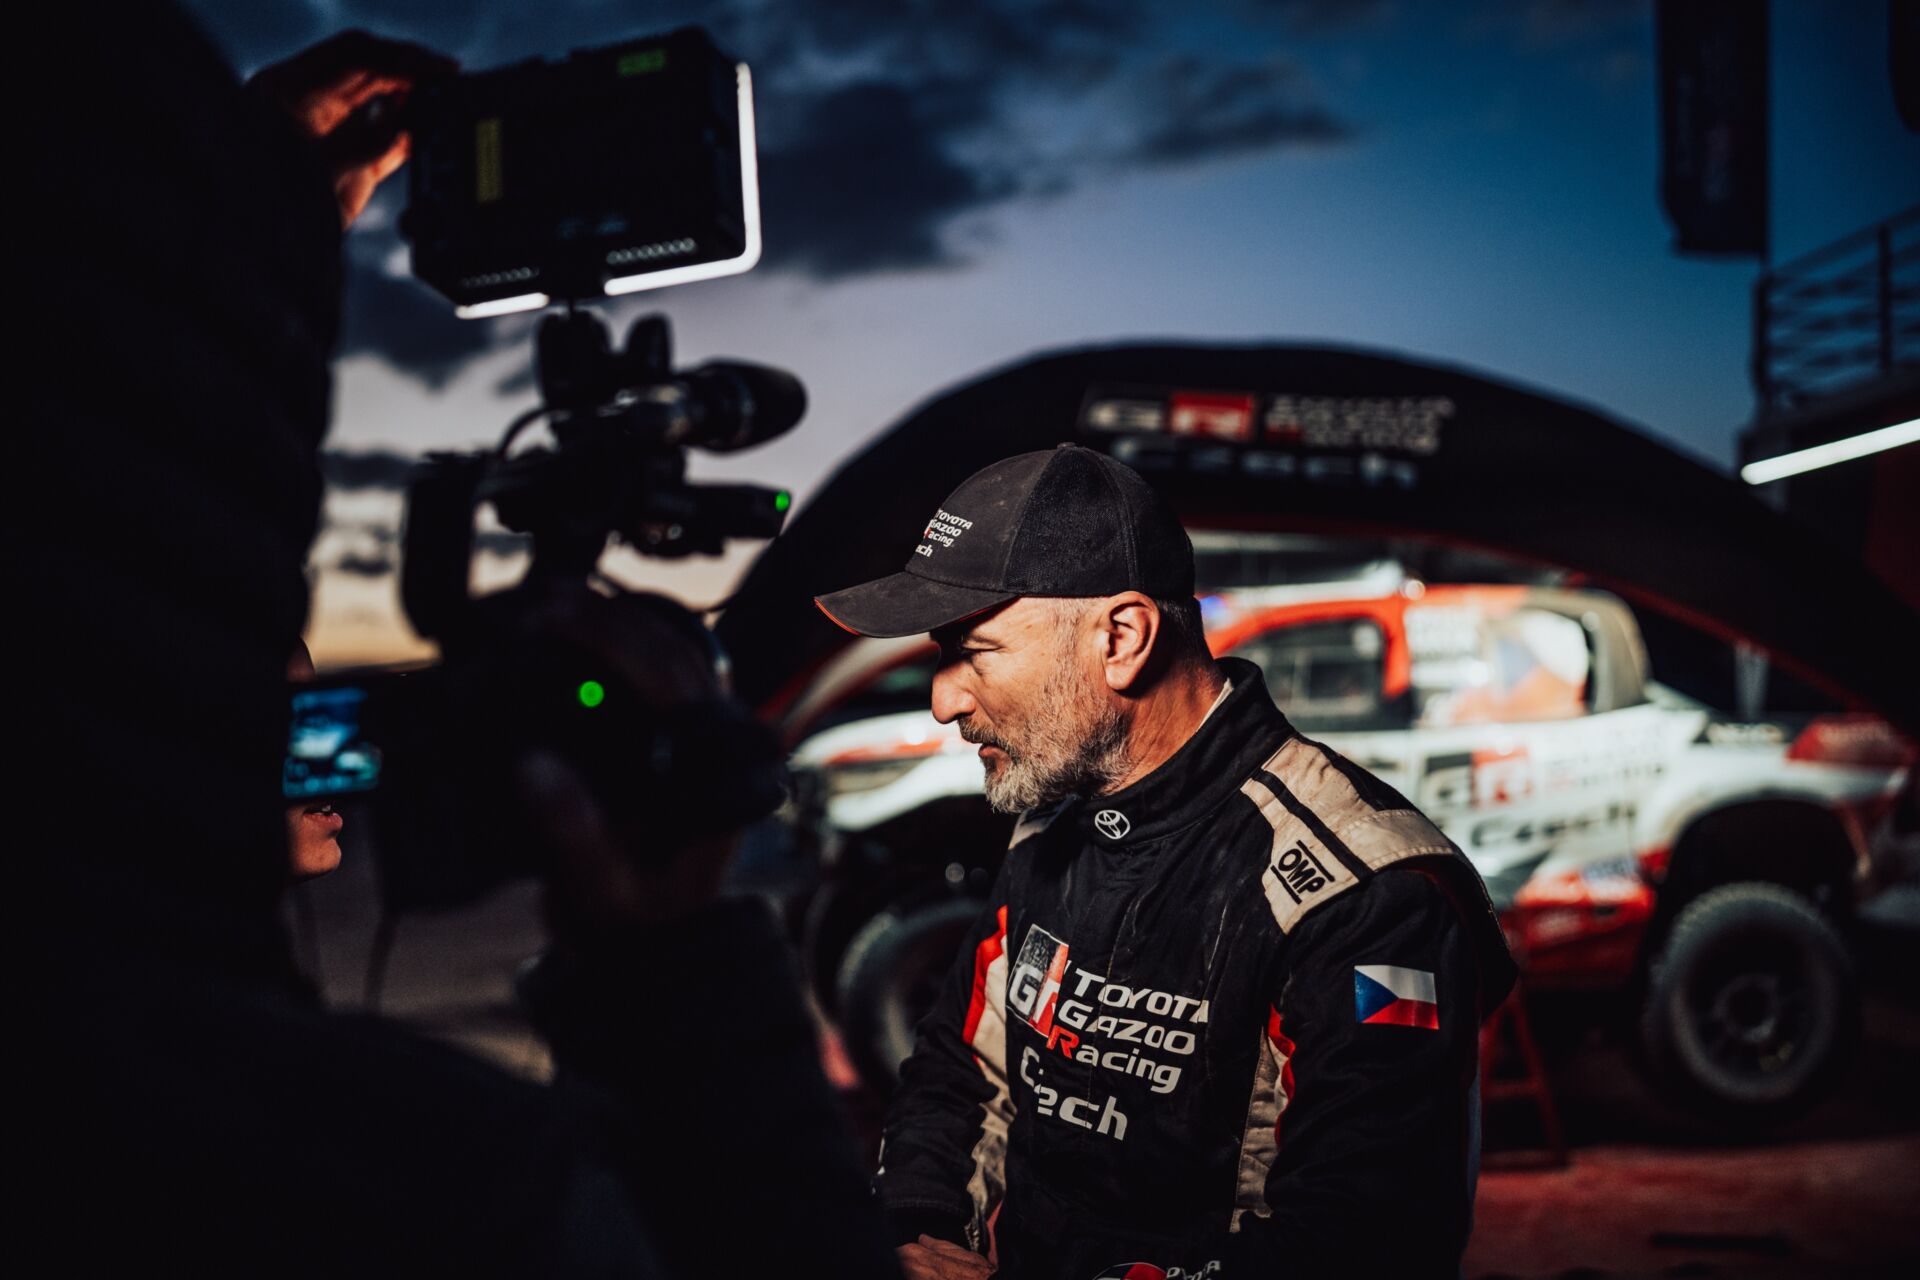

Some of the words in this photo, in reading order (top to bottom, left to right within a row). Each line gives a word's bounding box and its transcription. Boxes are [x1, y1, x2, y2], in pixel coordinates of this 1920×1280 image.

[1278, 848, 1326, 894] OMP
[1073, 967, 1209, 1024] TOYOTA
[1058, 999, 1196, 1056] GAZOO
[1046, 1024, 1182, 1094] Racing
[1020, 1045, 1128, 1141] Cech
